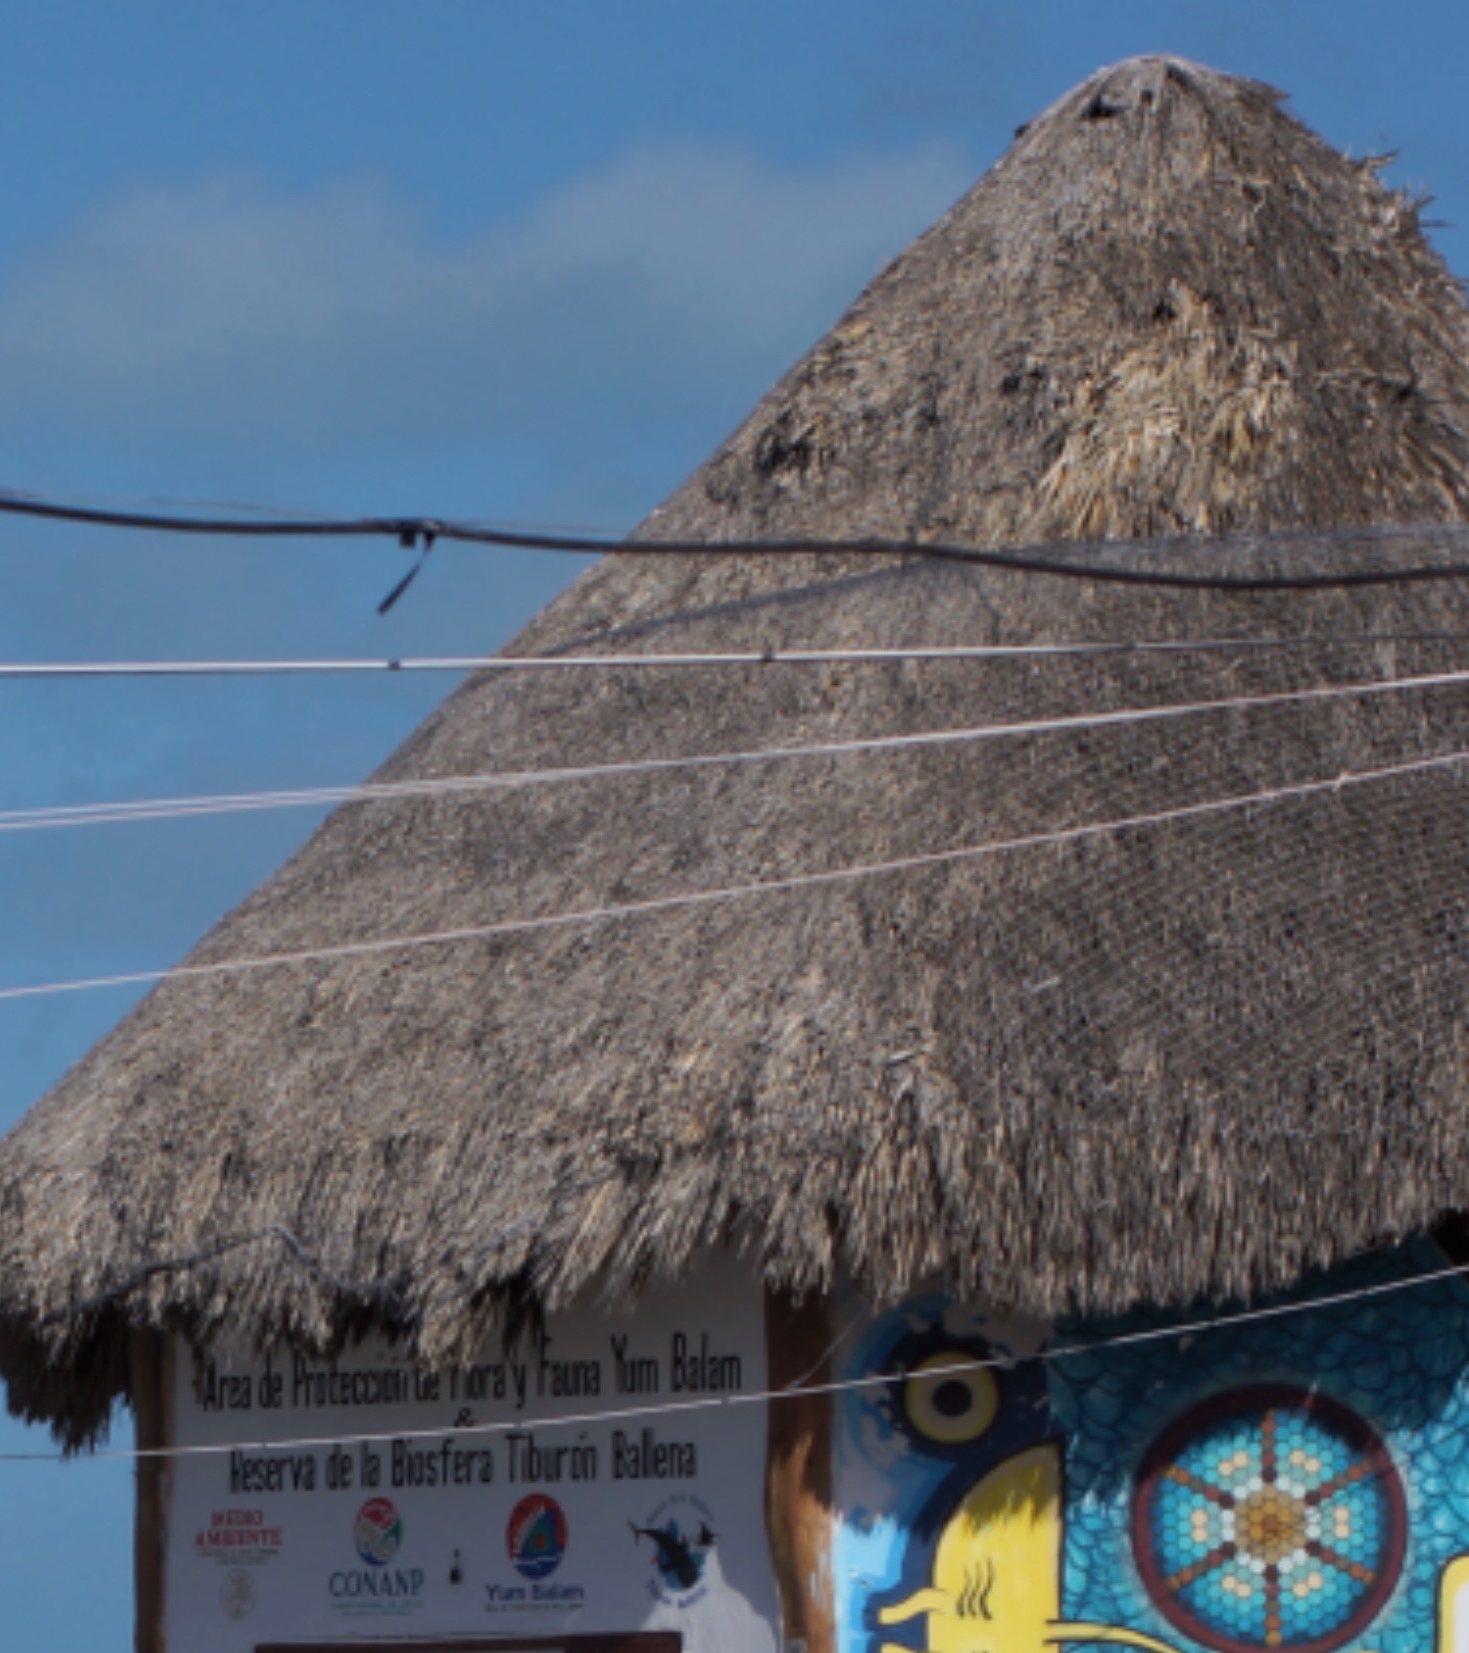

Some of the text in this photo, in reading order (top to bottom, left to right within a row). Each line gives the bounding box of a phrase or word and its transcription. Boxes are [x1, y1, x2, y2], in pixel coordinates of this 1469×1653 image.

[258, 1354, 283, 1409] de
[509, 1360, 527, 1408] y
[537, 1333, 601, 1397] Fauna
[610, 1333, 660, 1393] Yum
[671, 1331, 743, 1393] Balam
[230, 1427, 698, 1493] Reserva de la Biosfera Tiburón Ballena
[328, 1568, 425, 1598] CONANP
[484, 1583, 526, 1601] Yum
